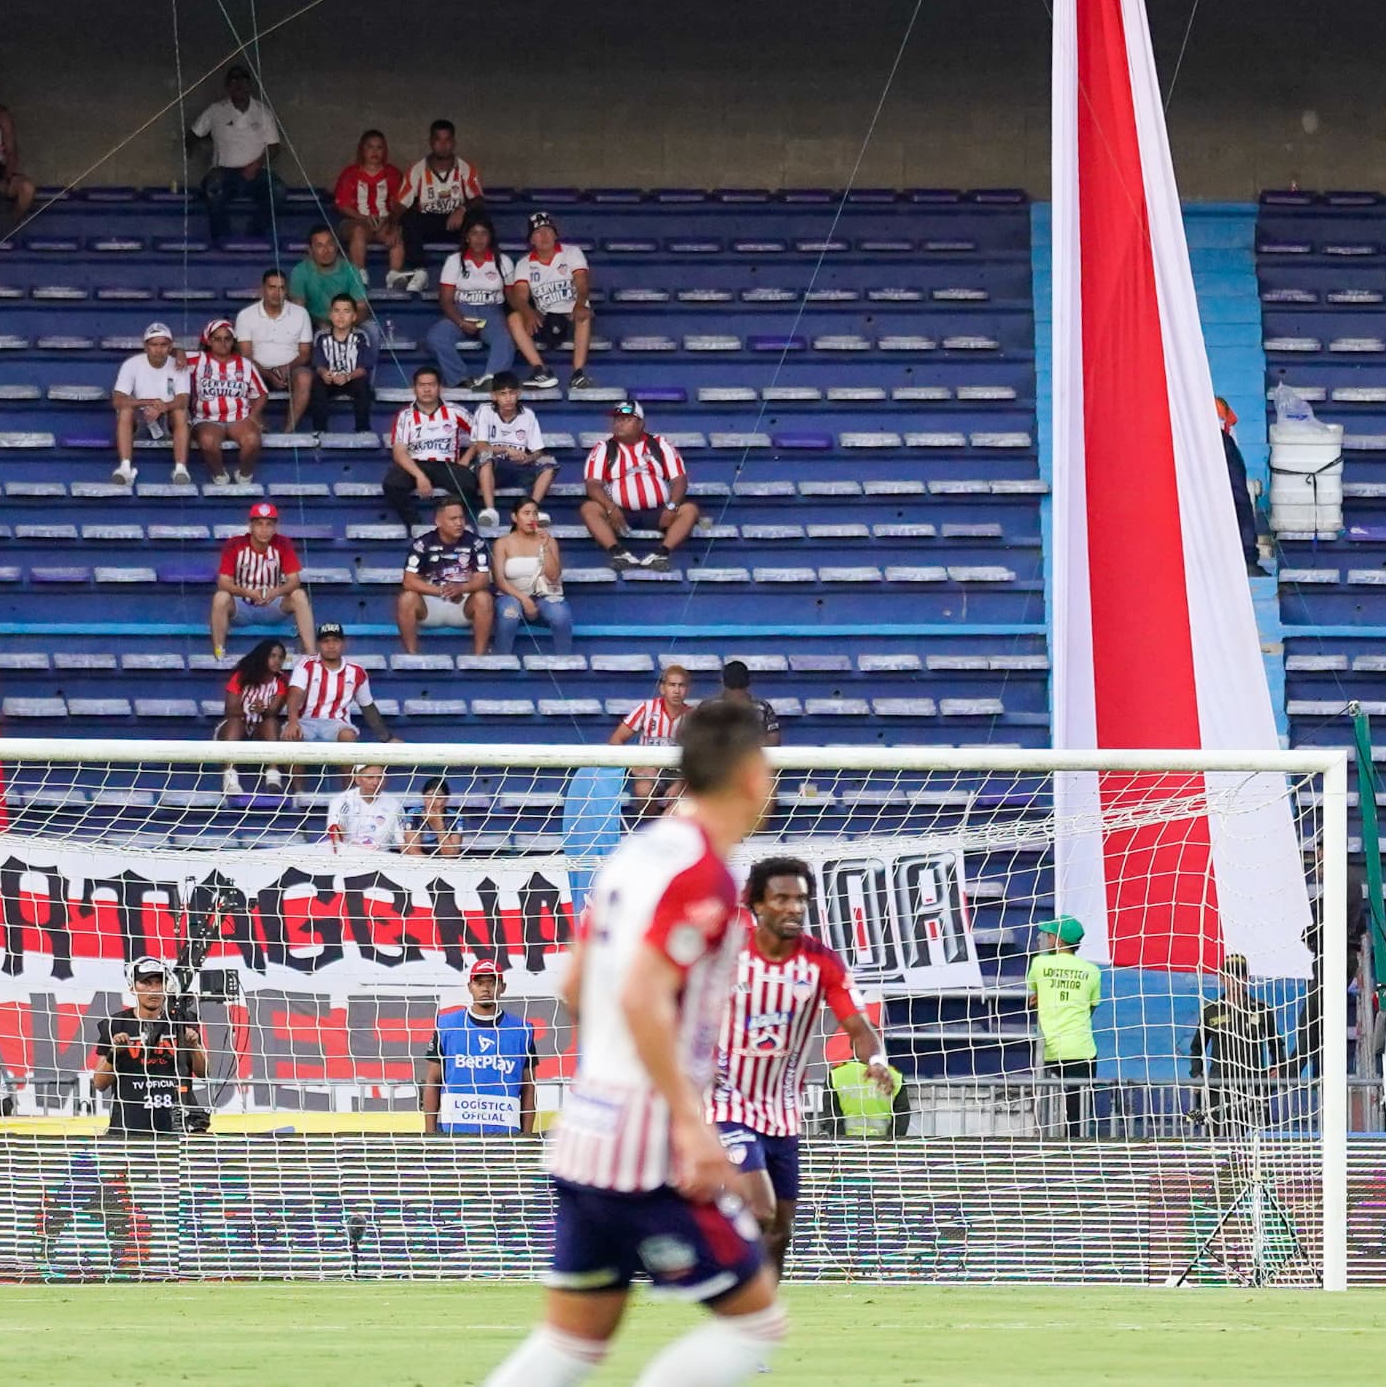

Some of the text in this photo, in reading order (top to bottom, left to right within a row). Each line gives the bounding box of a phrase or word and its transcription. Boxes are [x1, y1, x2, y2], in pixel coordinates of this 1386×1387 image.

[454, 1052, 516, 1076] BetPlay
[143, 1094, 173, 1109] 288
[461, 1111, 506, 1123] OFICIAL
